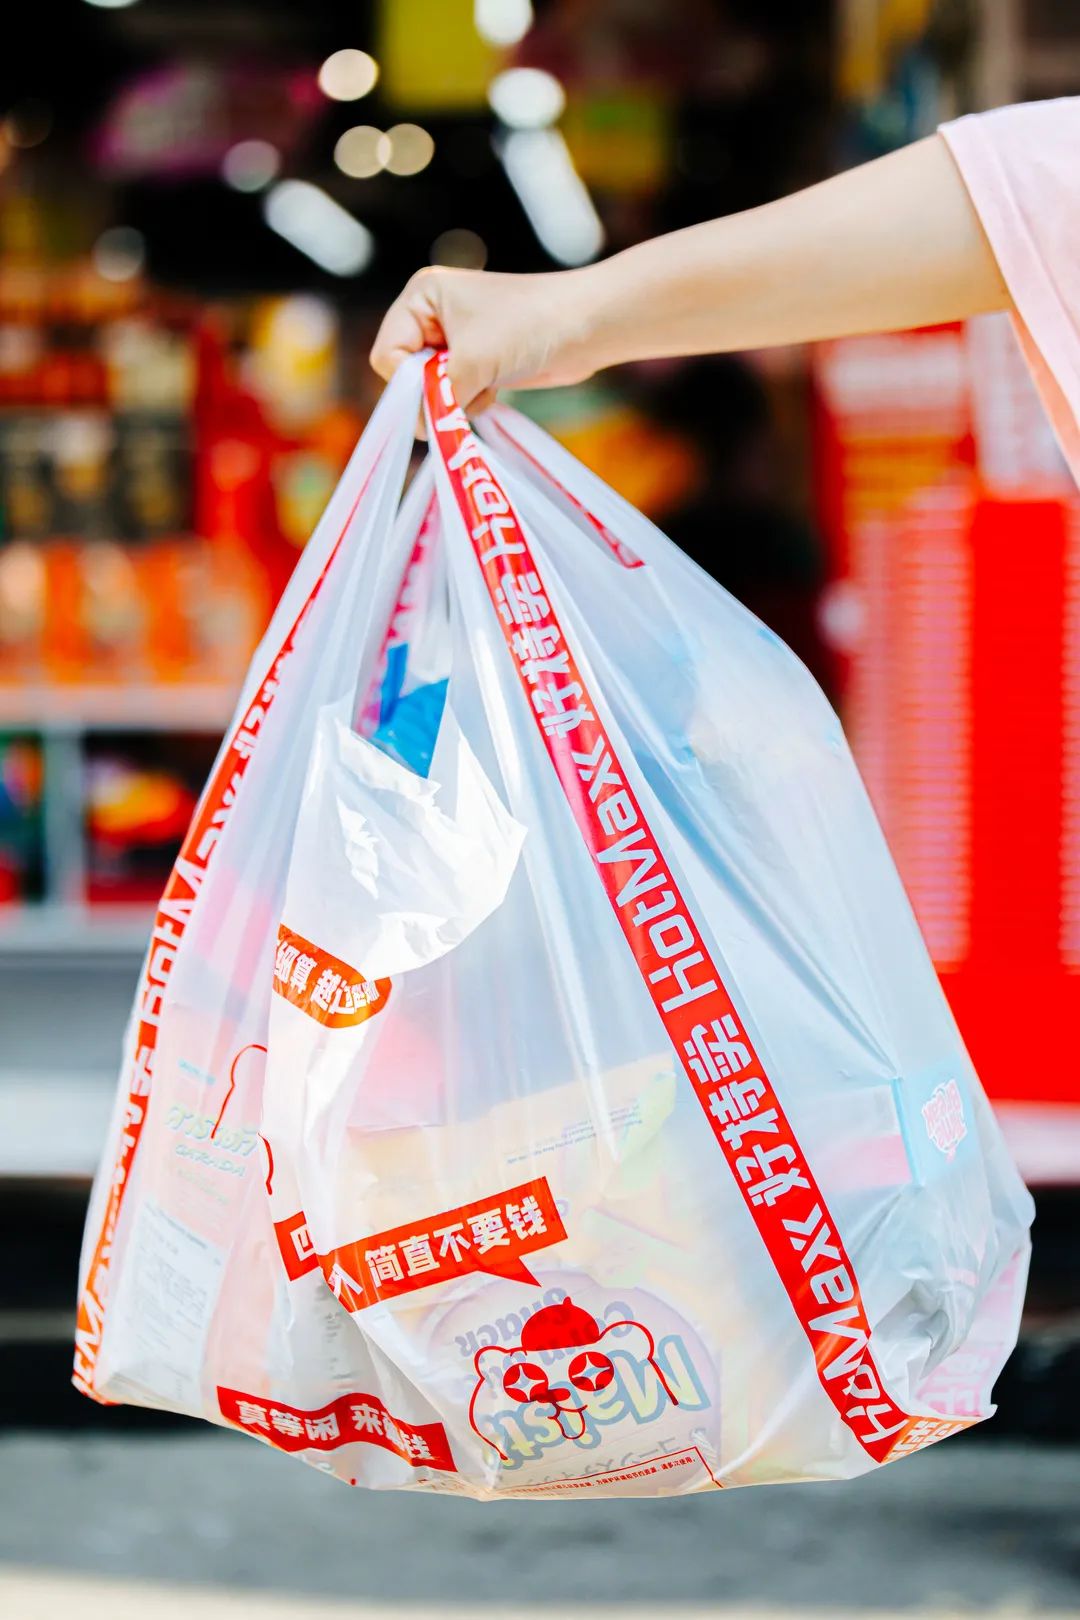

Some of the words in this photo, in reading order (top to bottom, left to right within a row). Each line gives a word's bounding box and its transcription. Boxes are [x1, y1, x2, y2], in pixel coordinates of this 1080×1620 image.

[364, 1195, 548, 1289] 简直不要钱
